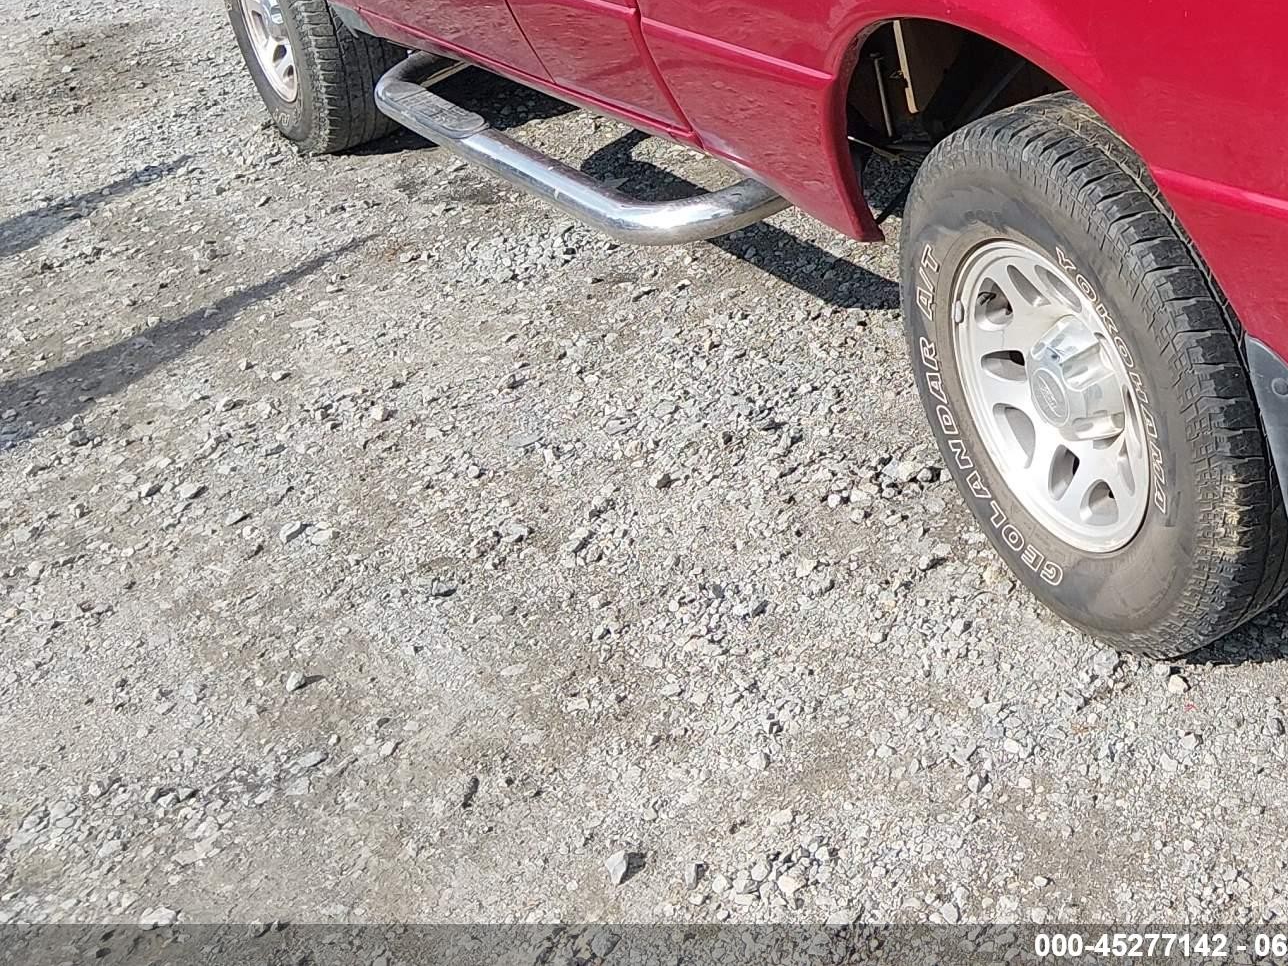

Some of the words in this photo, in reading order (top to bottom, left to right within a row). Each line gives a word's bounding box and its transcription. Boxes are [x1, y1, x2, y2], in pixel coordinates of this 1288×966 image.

[914, 244, 943, 322] A/T
[1055, 247, 1169, 515] YOKOHAMA
[918, 336, 1064, 587] GEOLANDAR
